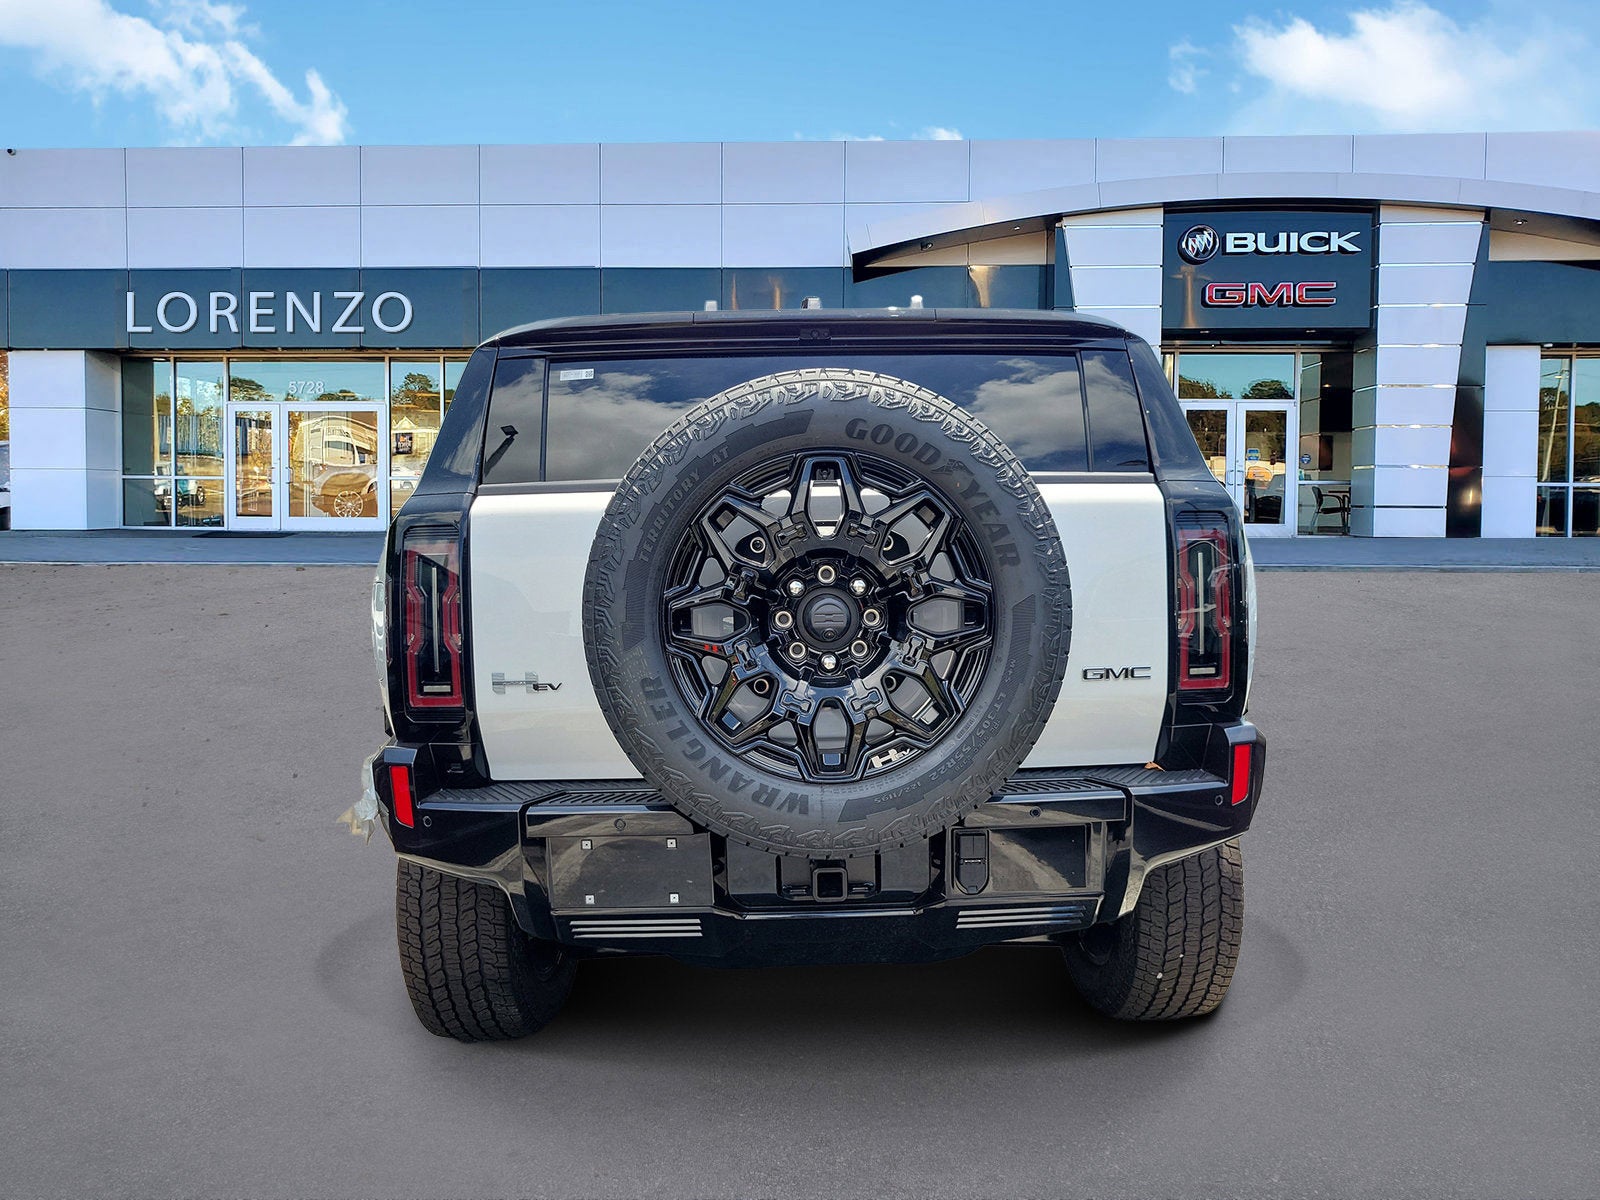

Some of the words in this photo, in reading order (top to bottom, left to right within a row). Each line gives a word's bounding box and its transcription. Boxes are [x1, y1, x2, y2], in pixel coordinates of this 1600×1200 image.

[1225, 230, 1362, 255] BUICK
[1205, 281, 1338, 306] GMC
[126, 290, 414, 334] LORENZO
[288, 380, 326, 394] 5728
[640, 468, 702, 563] TERRITORY
[712, 445, 730, 467] AT
[1082, 665, 1152, 680] GMC
[638, 675, 810, 816] WRANGLER
